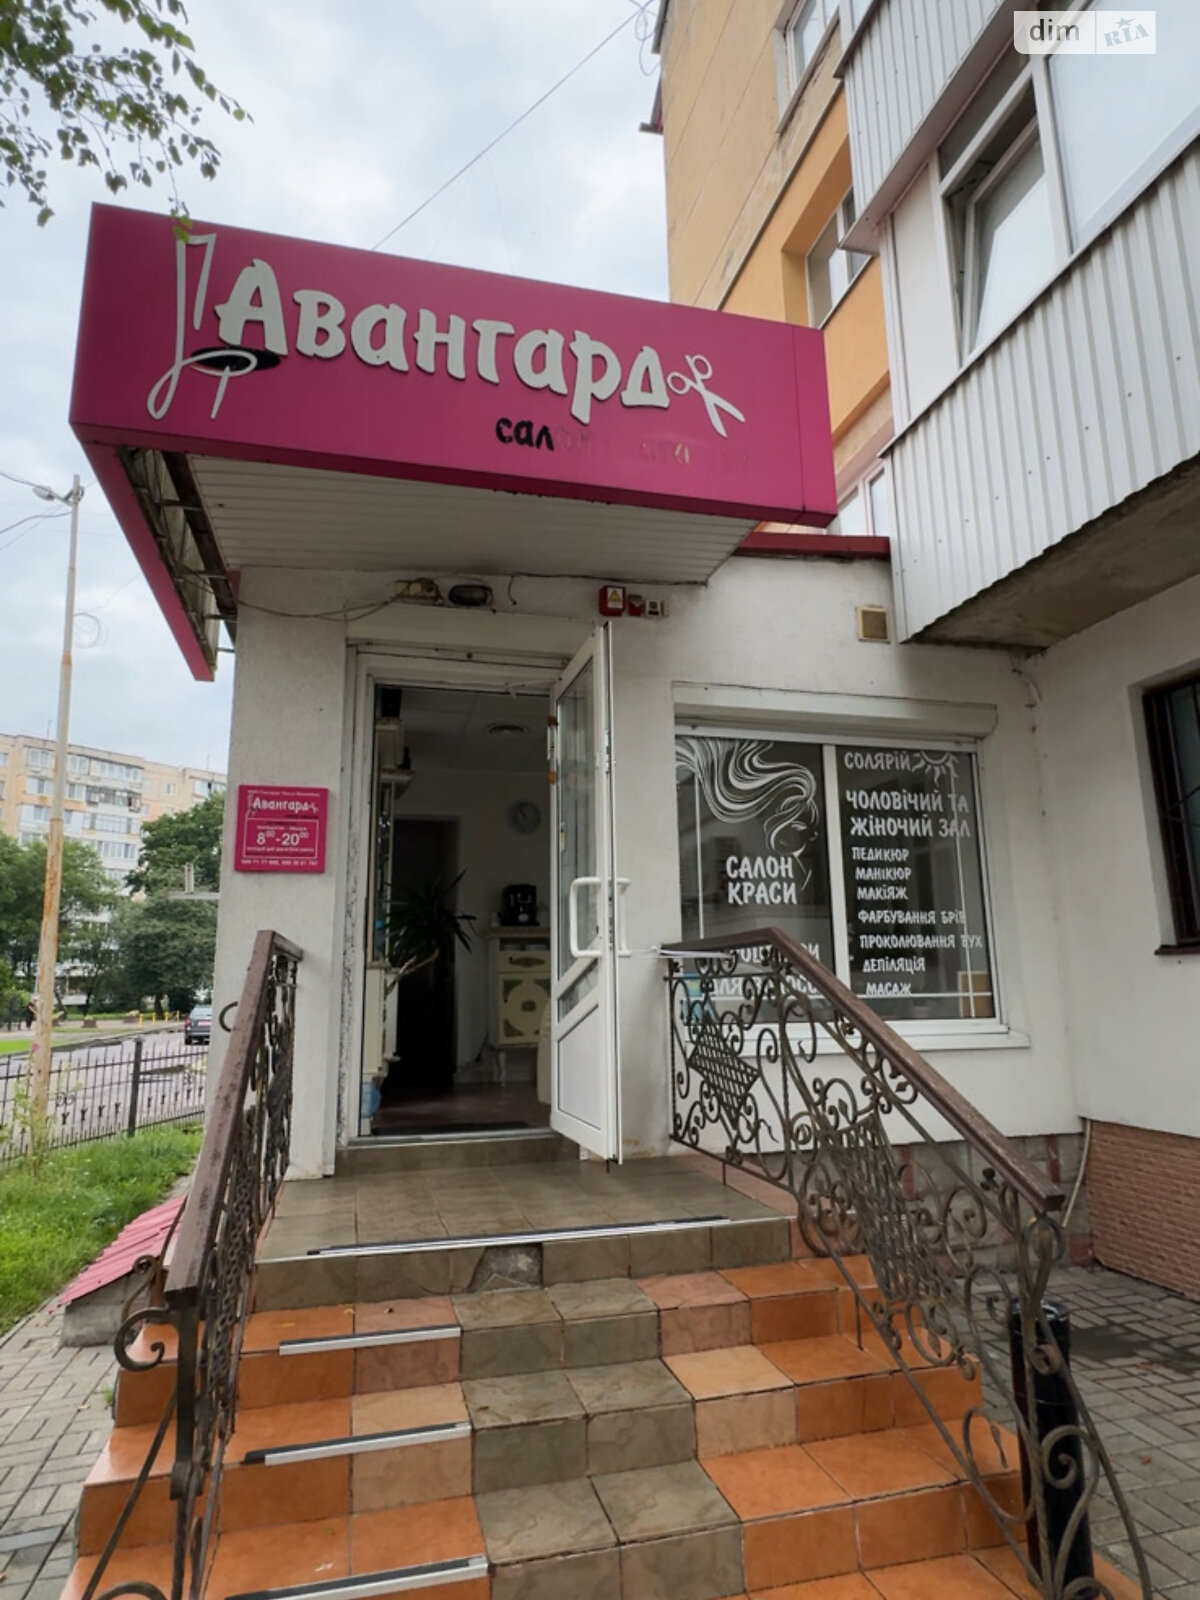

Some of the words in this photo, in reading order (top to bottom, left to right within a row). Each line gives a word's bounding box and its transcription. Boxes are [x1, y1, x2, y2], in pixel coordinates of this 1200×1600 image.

[213, 258, 671, 425] Авангард
[843, 751, 912, 771] СОЛЯРІЙ
[845, 789, 944, 813] ЧОЛОВІЧИЙ
[850, 814, 934, 838] ЖІНОЧИЙ
[938, 818, 971, 838] ЗАЛ
[851, 846, 910, 862] ПЕДИКЮР
[726, 855, 794, 879] САЛОН
[855, 866, 912, 881] МАНІКЮР
[728, 881, 798, 906] КРАСИ
[857, 884, 909, 900] МАКІЯЖ
[858, 909, 936, 924] ФАРБУВАННЯ
[859, 934, 956, 949] ПРОКОЛЮВАННЯ
[862, 956, 926, 975] ДЕПІЛЯЦІЯ
[865, 982, 912, 997] МАСАЖ
